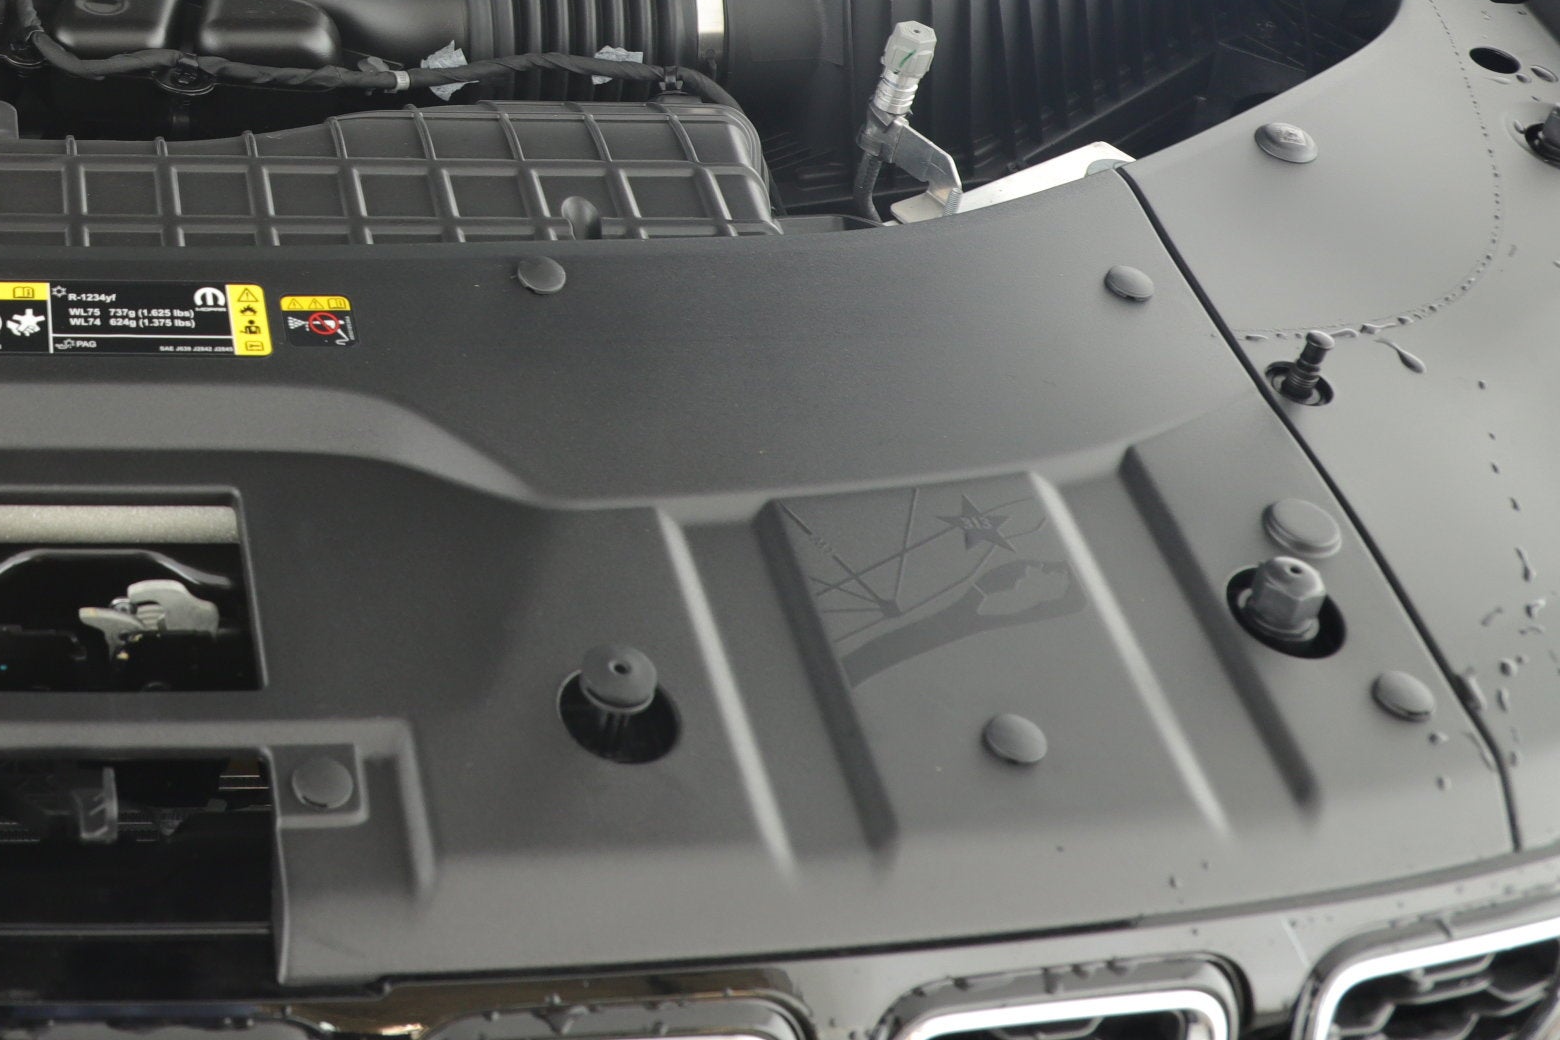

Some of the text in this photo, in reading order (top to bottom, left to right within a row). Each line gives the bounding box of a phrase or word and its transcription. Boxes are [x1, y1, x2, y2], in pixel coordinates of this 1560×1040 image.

[68, 293, 116, 303] R-1234yf
[68, 308, 195, 318] WL75 737g (1.625 lbs)
[69, 318, 196, 328] WL74 624g (1.375 lbs)
[76, 340, 97, 348] PAG
